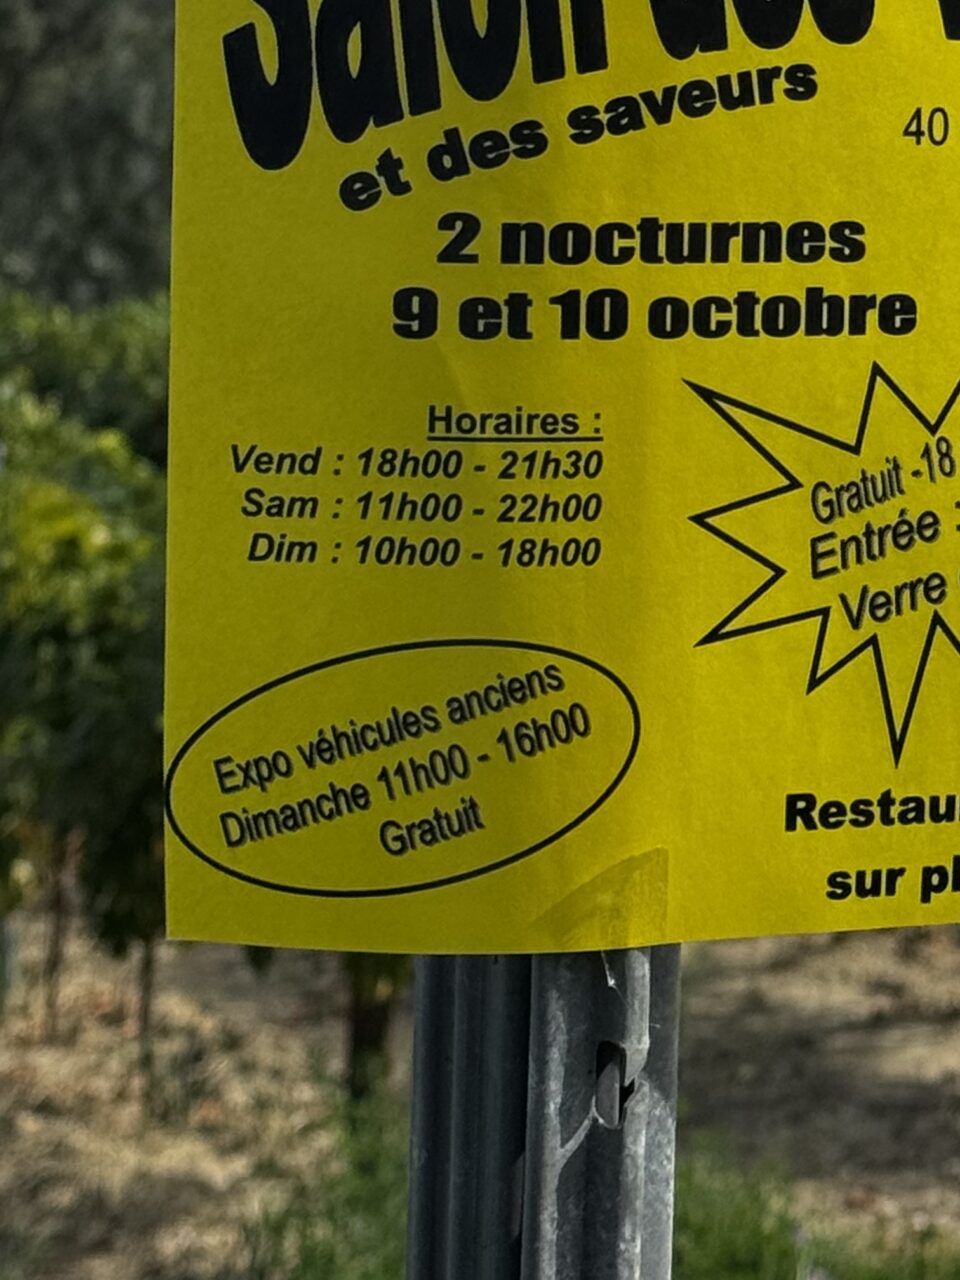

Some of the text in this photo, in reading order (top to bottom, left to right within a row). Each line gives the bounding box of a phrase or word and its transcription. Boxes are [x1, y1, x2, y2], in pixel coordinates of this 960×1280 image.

[338, 63, 818, 212] et des saveurs
[903, 107, 949, 146] 40
[436, 211, 866, 266] 2 nocturnes
[392, 286, 917, 341] 9 et 10 octobre
[428, 404, 580, 435] Horaires
[231, 444, 323, 476] Vend
[358, 447, 463, 479] 18h00
[497, 450, 603, 480] 21h30
[241, 487, 319, 519] Sam
[357, 491, 463, 523] 11h00
[496, 493, 602, 523] 22h00
[811, 456, 906, 525] Gratuit
[247, 532, 318, 563] Dim
[356, 535, 461, 567] 10h00
[497, 537, 601, 568] 18h00
[810, 508, 940, 580] Entrée
[838, 572, 947, 630] Verre
[213, 664, 565, 795] Expo véhicules anciens
[219, 781, 371, 849] Dimanche
[377, 743, 470, 805] 11h00
[496, 702, 590, 761] 16h00
[379, 796, 485, 857] Gratuit
[826, 867, 906, 900] sur
